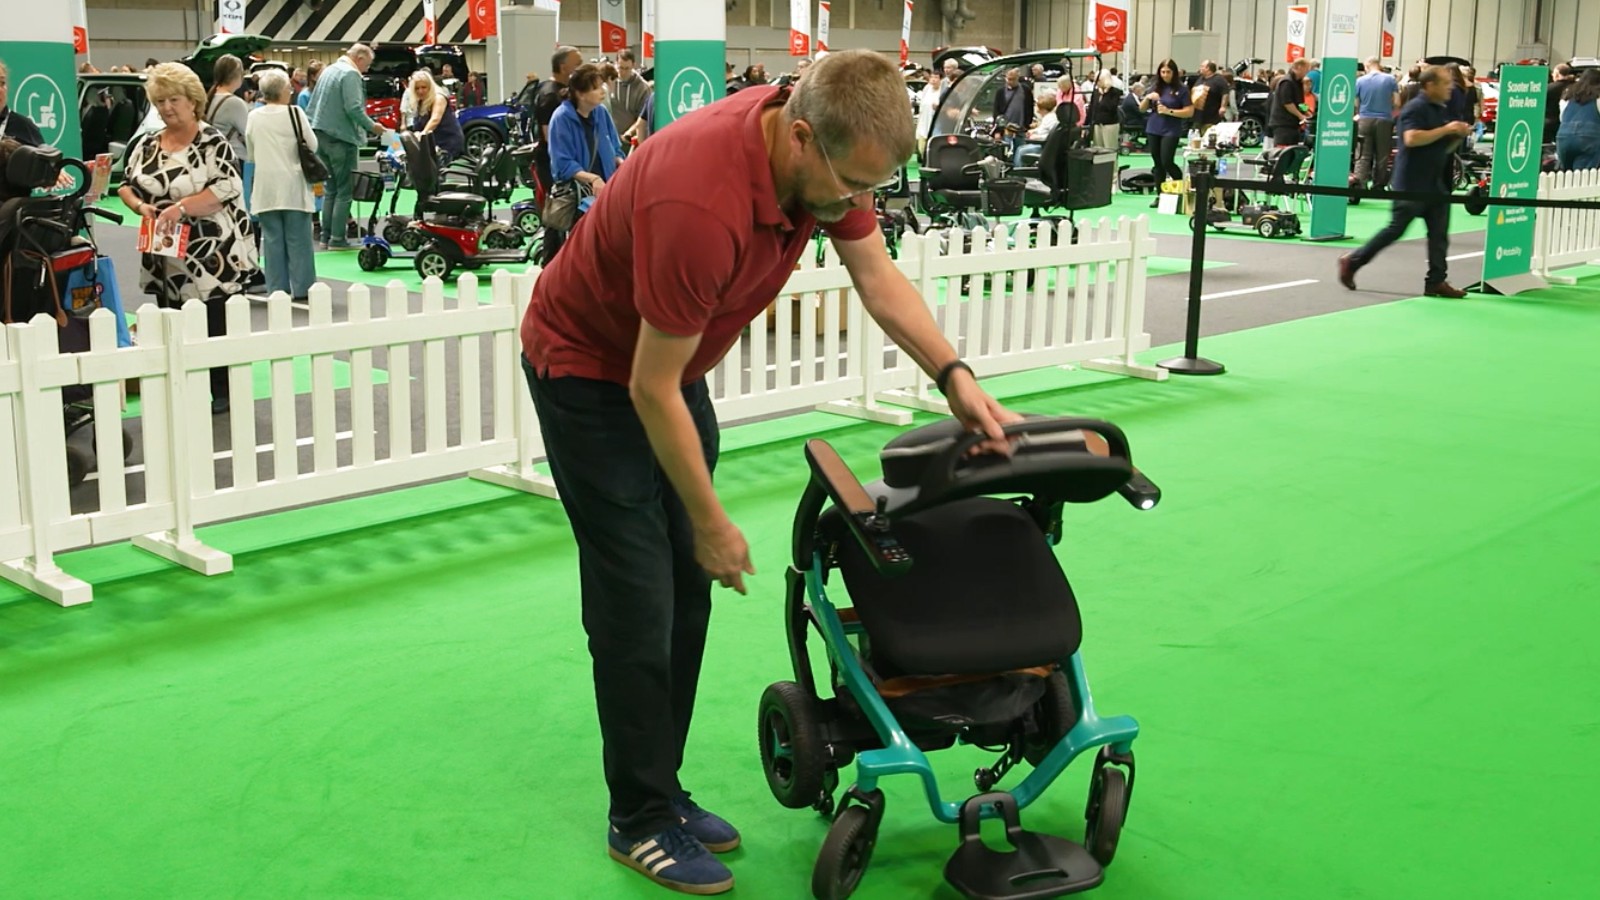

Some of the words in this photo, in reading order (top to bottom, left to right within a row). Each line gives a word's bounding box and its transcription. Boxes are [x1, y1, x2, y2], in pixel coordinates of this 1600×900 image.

[1507, 81, 1529, 93] Scooter
[1530, 81, 1542, 93] Test
[1509, 95, 1524, 108] Drive
[1524, 96, 1537, 108] Area
